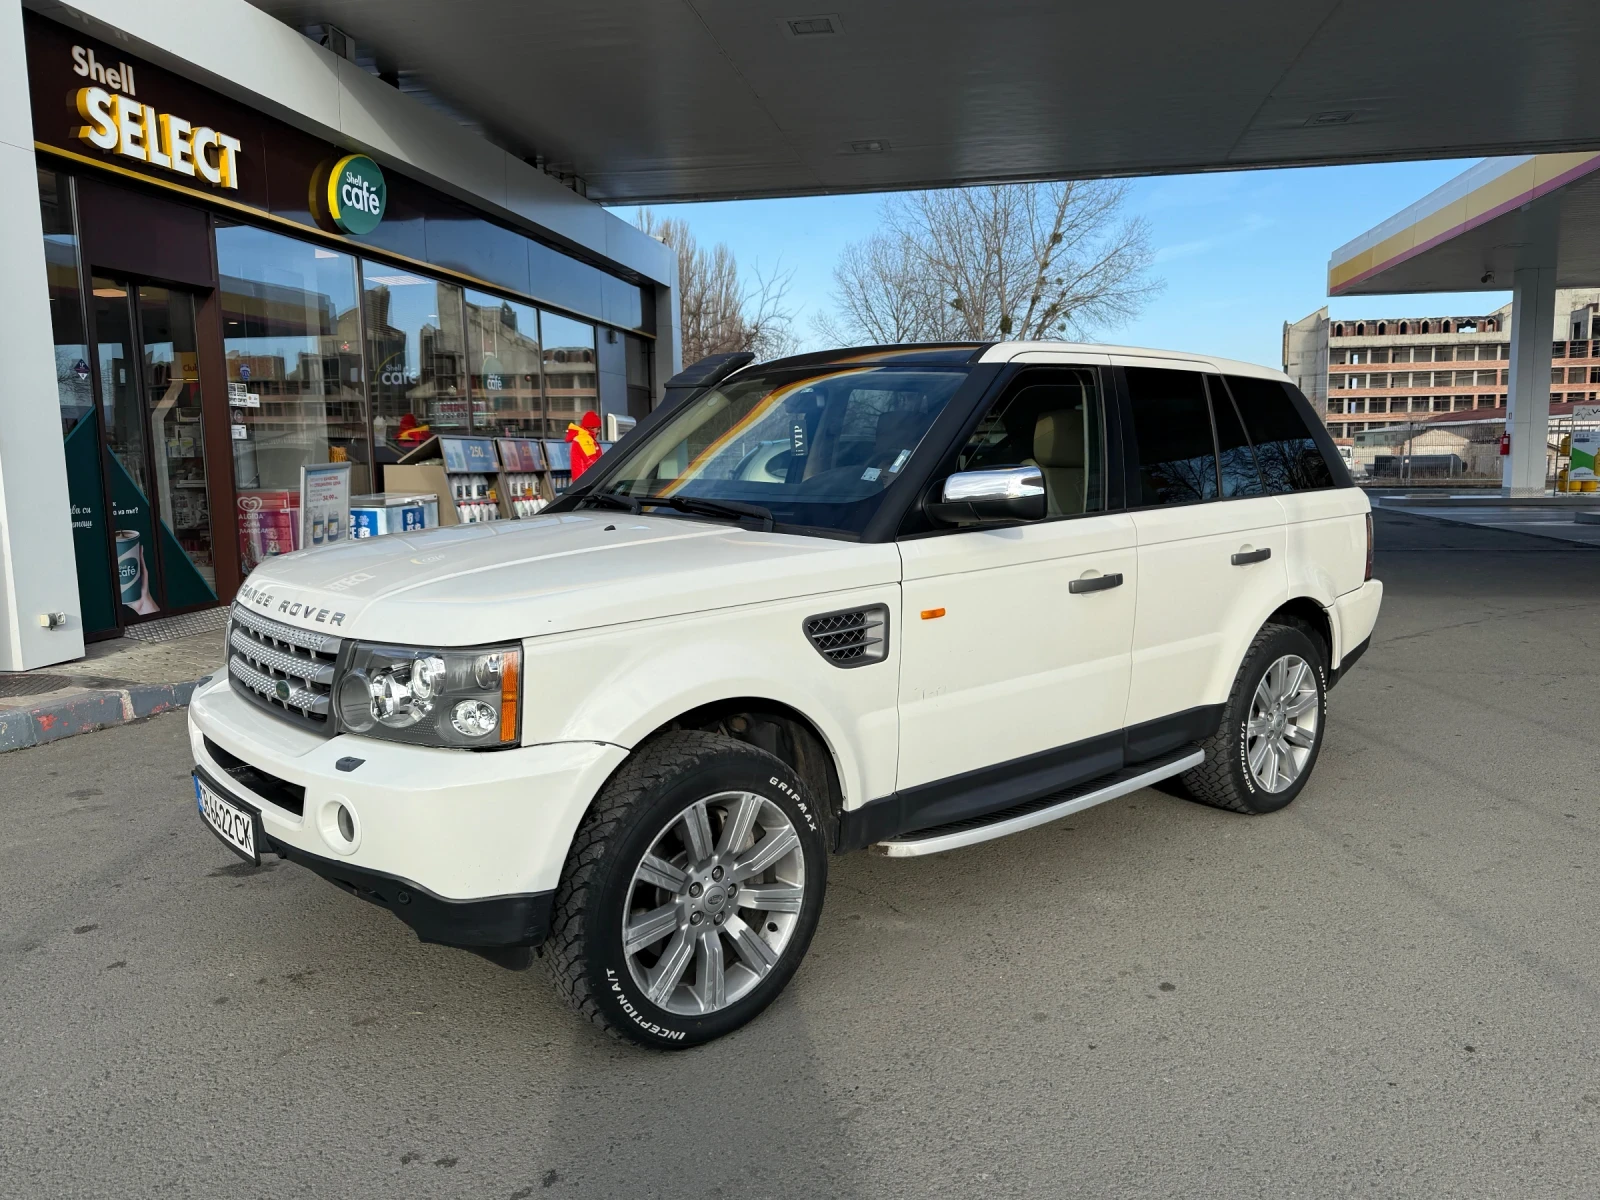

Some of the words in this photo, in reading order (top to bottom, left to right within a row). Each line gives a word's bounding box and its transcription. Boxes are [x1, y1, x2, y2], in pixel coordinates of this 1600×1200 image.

[72, 45, 136, 96] Shell
[77, 87, 241, 190] SELECT
[342, 181, 380, 215] café
[346, 172, 362, 187] Shell
[381, 365, 417, 385] café
[794, 425, 804, 448] VIP
[241, 584, 274, 607] RANGE
[278, 600, 346, 626] ROVER
[769, 776, 817, 831] GRIPMAX
[606, 968, 621, 991] A/T
[617, 994, 686, 1040] INCEPTION
